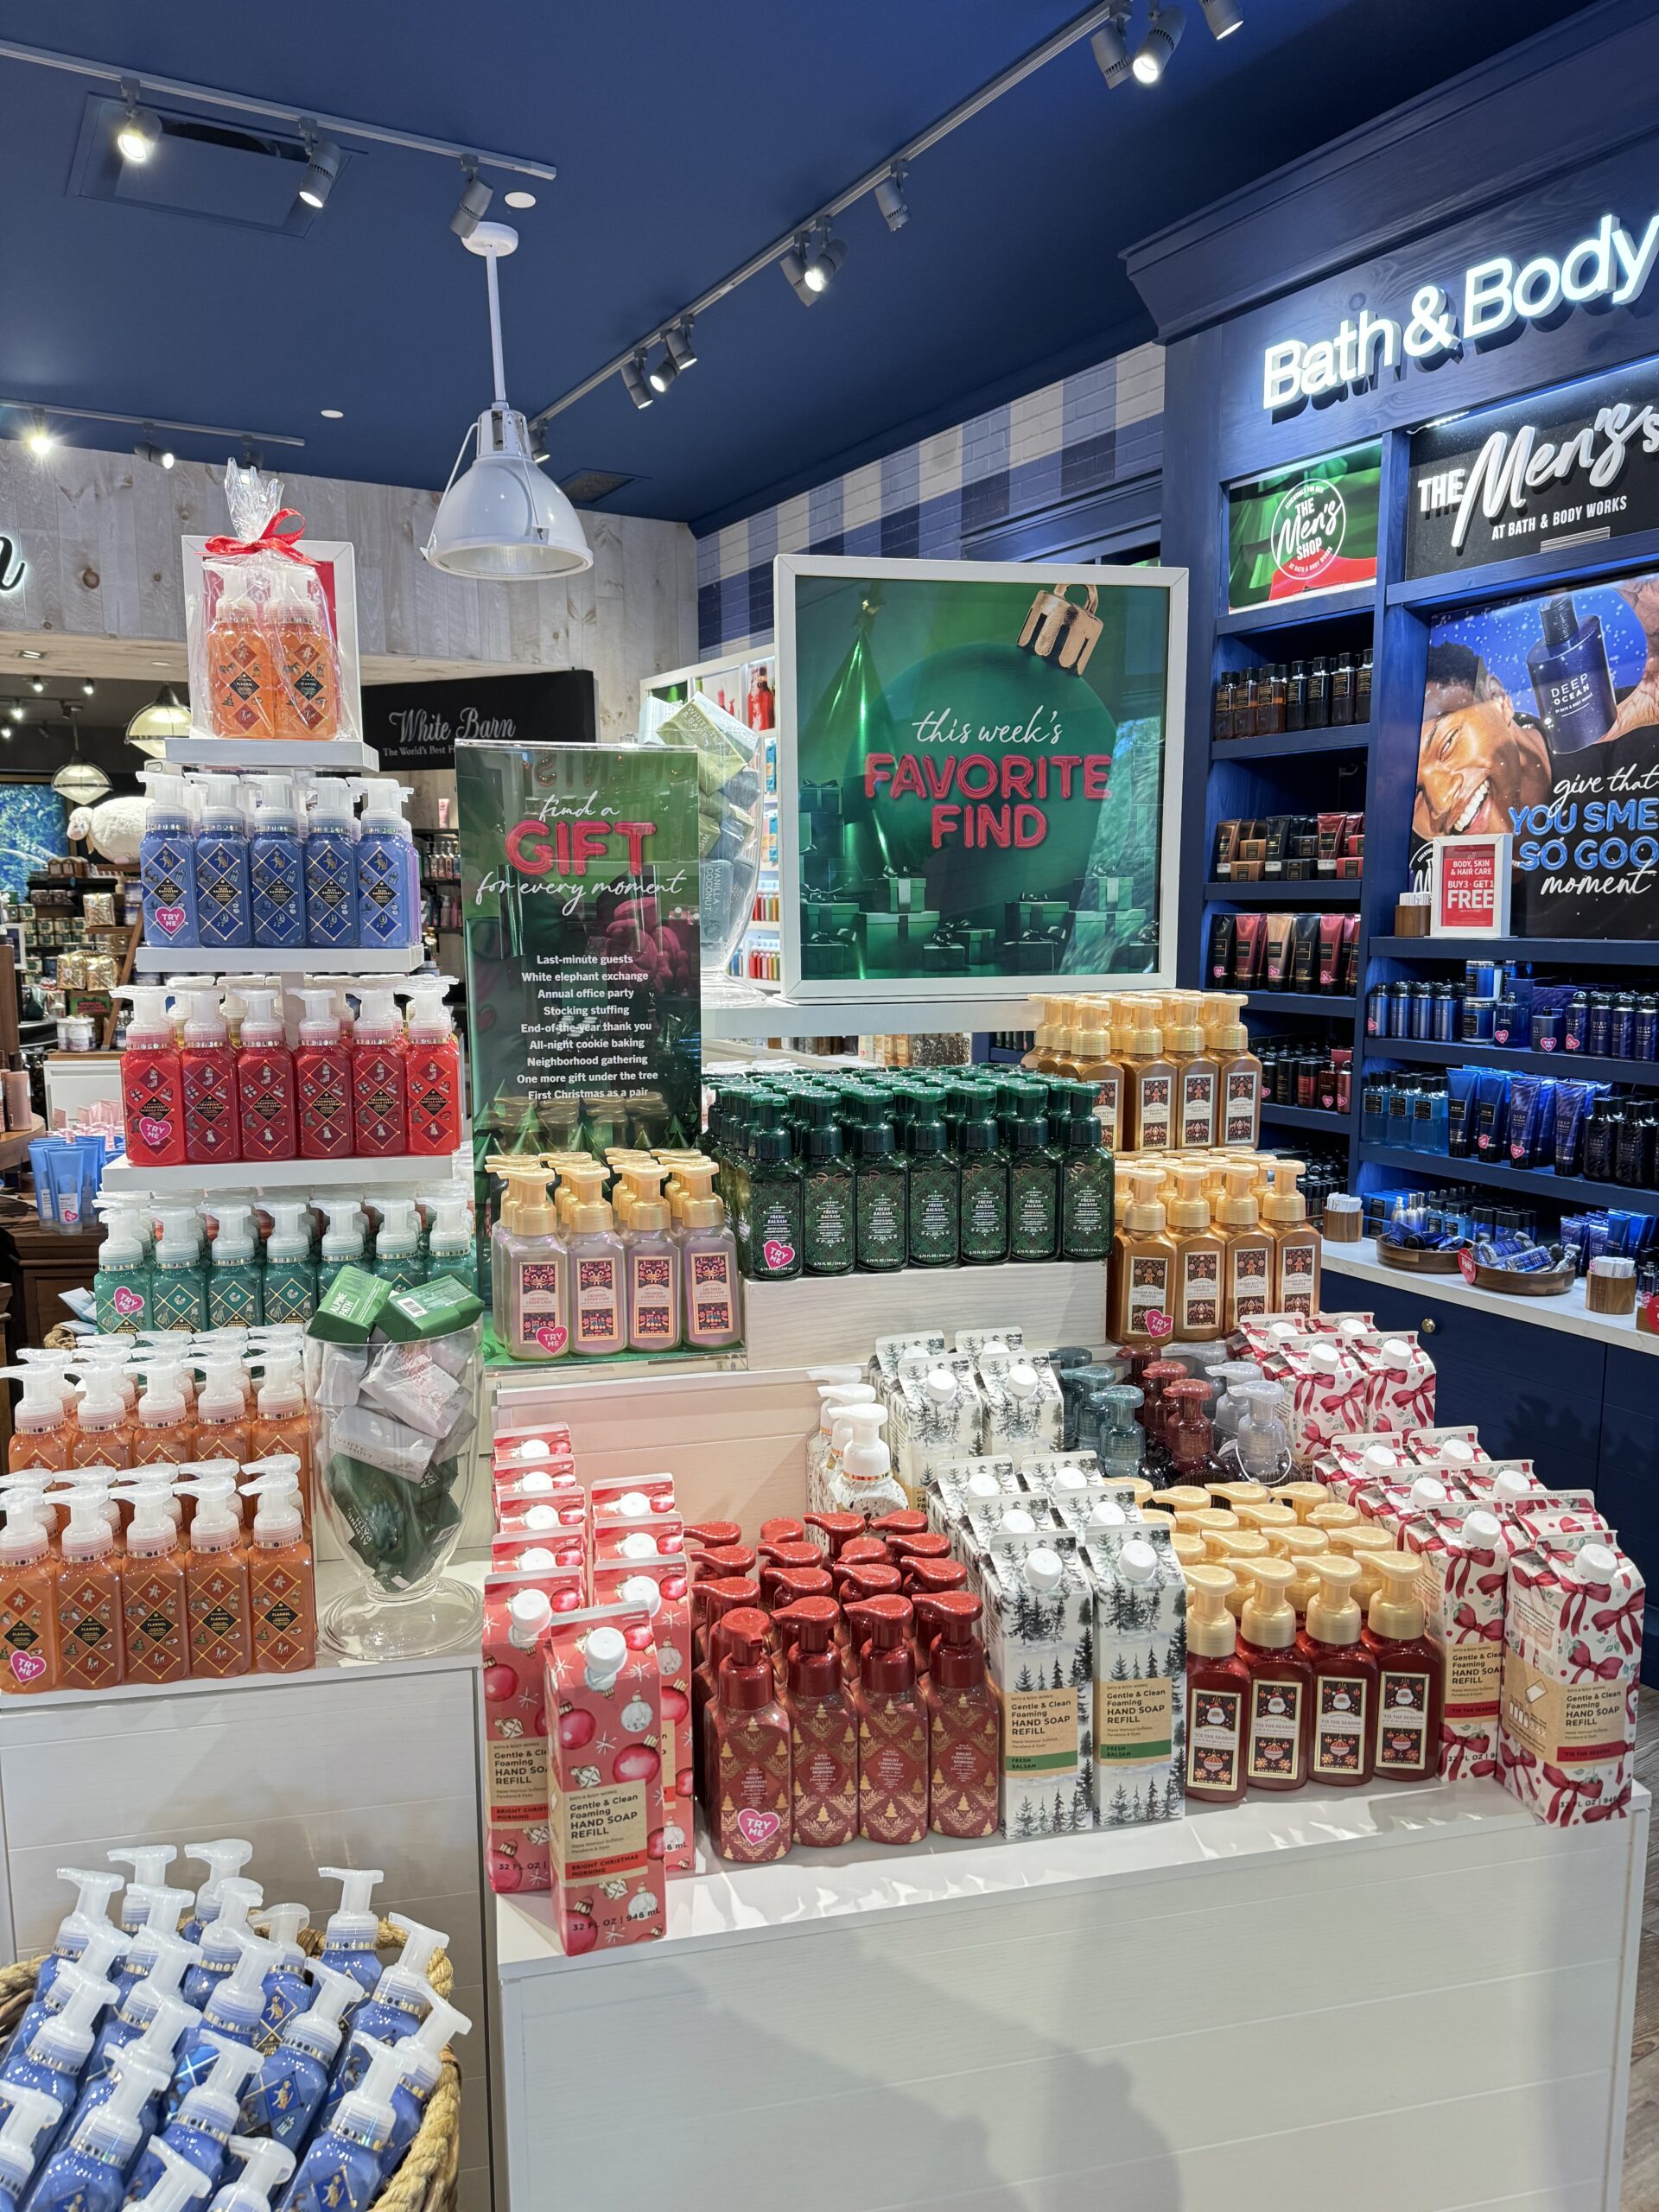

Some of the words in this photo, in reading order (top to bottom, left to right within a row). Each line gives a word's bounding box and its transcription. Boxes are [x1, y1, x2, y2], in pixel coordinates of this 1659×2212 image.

[1262, 309, 1401, 410] Bath
[1403, 285, 1461, 357] &
[1463, 214, 1659, 339] Body
[1418, 468, 1465, 512] THE
[1451, 403, 1653, 547] Men's
[1295, 498, 1315, 517] THE
[1492, 525, 1505, 540] AT
[1508, 518, 1535, 536] BATH
[1540, 514, 1548, 529] &
[1553, 506, 1583, 526] BODY
[1586, 496, 1627, 518] WORKS
[1277, 500, 1342, 567] Men's
[1296, 537, 1322, 561] SHOP
[1551, 673, 1588, 697] DEEP
[1554, 683, 1590, 705] OCEAN
[389, 709, 451, 743] White
[455, 707, 516, 739] Barn
[912, 708, 972, 746] this
[978, 705, 1062, 746] week's
[383, 747, 398, 756] The
[399, 746, 427, 756] World's
[864, 753, 1113, 800] FAVORITE
[1548, 774, 1605, 818] give
[1606, 763, 1659, 791] that
[538, 790, 598, 823] find
[601, 805, 620, 817] a
[1508, 803, 1578, 836] YOU
[1583, 798, 1659, 833] SME
[931, 804, 1048, 849] FIND
[505, 820, 657, 876] GIFT
[1519, 839, 1568, 872] SO
[1574, 836, 1659, 870] GOO
[1541, 859, 1657, 895] moment
[475, 871, 515, 905] for
[519, 881, 587, 916] every
[591, 869, 687, 894] moment
[704, 867, 714, 912] COCONUT
[713, 867, 721, 905] VANILLA
[1447, 889, 1494, 909] FREE
[537, 955, 598, 964] Last-minute
[601, 955, 633, 965] guests
[521, 972, 552, 982] White
[555, 972, 599, 982] elephant
[602, 971, 648, 982] exchange
[537, 989, 573, 999] Annual
[576, 989, 605, 998] office
[607, 989, 634, 999] party
[543, 1006, 588, 1016] Stocking
[591, 1006, 630, 1016] stuffing
[521, 1023, 601, 1033] End-of-the-year
[603, 1022, 631, 1032] thank
[633, 1023, 652, 1033] you
[530, 1040, 573, 1050] All-night
[575, 1039, 608, 1048] cookie
[611, 1039, 645, 1048] baking
[527, 1056, 598, 1067] Neighborhood
[601, 1055, 648, 1065] gathering
[517, 1075, 537, 1084] One
[569, 1073, 586, 1084] gift
[620, 1071, 636, 1080] the
[528, 1090, 551, 1100] First
[555, 1090, 604, 1099] Christmas
[629, 1088, 648, 1098] pair
[146, 1124, 165, 1134] TRY
[770, 1255, 781, 1264] ME
[771, 1247, 788, 1259] TRY
[118, 1300, 130, 1311] ME
[120, 1294, 138, 1307] TRY
[330, 1292, 346, 1312] ALPINE
[340, 1300, 353, 1317] PATH
[1151, 1324, 1163, 1332] ME
[1152, 1316, 1169, 1328] TRY
[543, 1332, 563, 1341] TRY
[18, 1658, 39, 1671] TRY
[19, 1668, 32, 1676] ME
[1139, 1705, 1165, 1713] SOAP
[1596, 1706, 1620, 1716] SOAP
[1044, 1715, 1071, 1725] SOAP
[1566, 1718, 1598, 1726] REFILL
[496, 1777, 532, 1785] REFILL
[569, 1802, 601, 1811] Gentle
[613, 1795, 638, 1804] Clean
[570, 1808, 611, 1820] Foaming
[570, 1818, 604, 1829] HAND
[607, 1811, 638, 1824] SOAP
[747, 1818, 772, 1830] TRY
[571, 1827, 609, 1839] REFILL
[748, 1827, 764, 1837] ME
[572, 1862, 598, 1871] BRIGHT
[600, 1853, 639, 1866] CHRISTMAS
[572, 1868, 607, 1877] MORNING
[588, 1921, 600, 1929] FL
[603, 1917, 617, 1927] OZ
[626, 1911, 645, 1922] 946
[647, 1907, 661, 1916] mL
